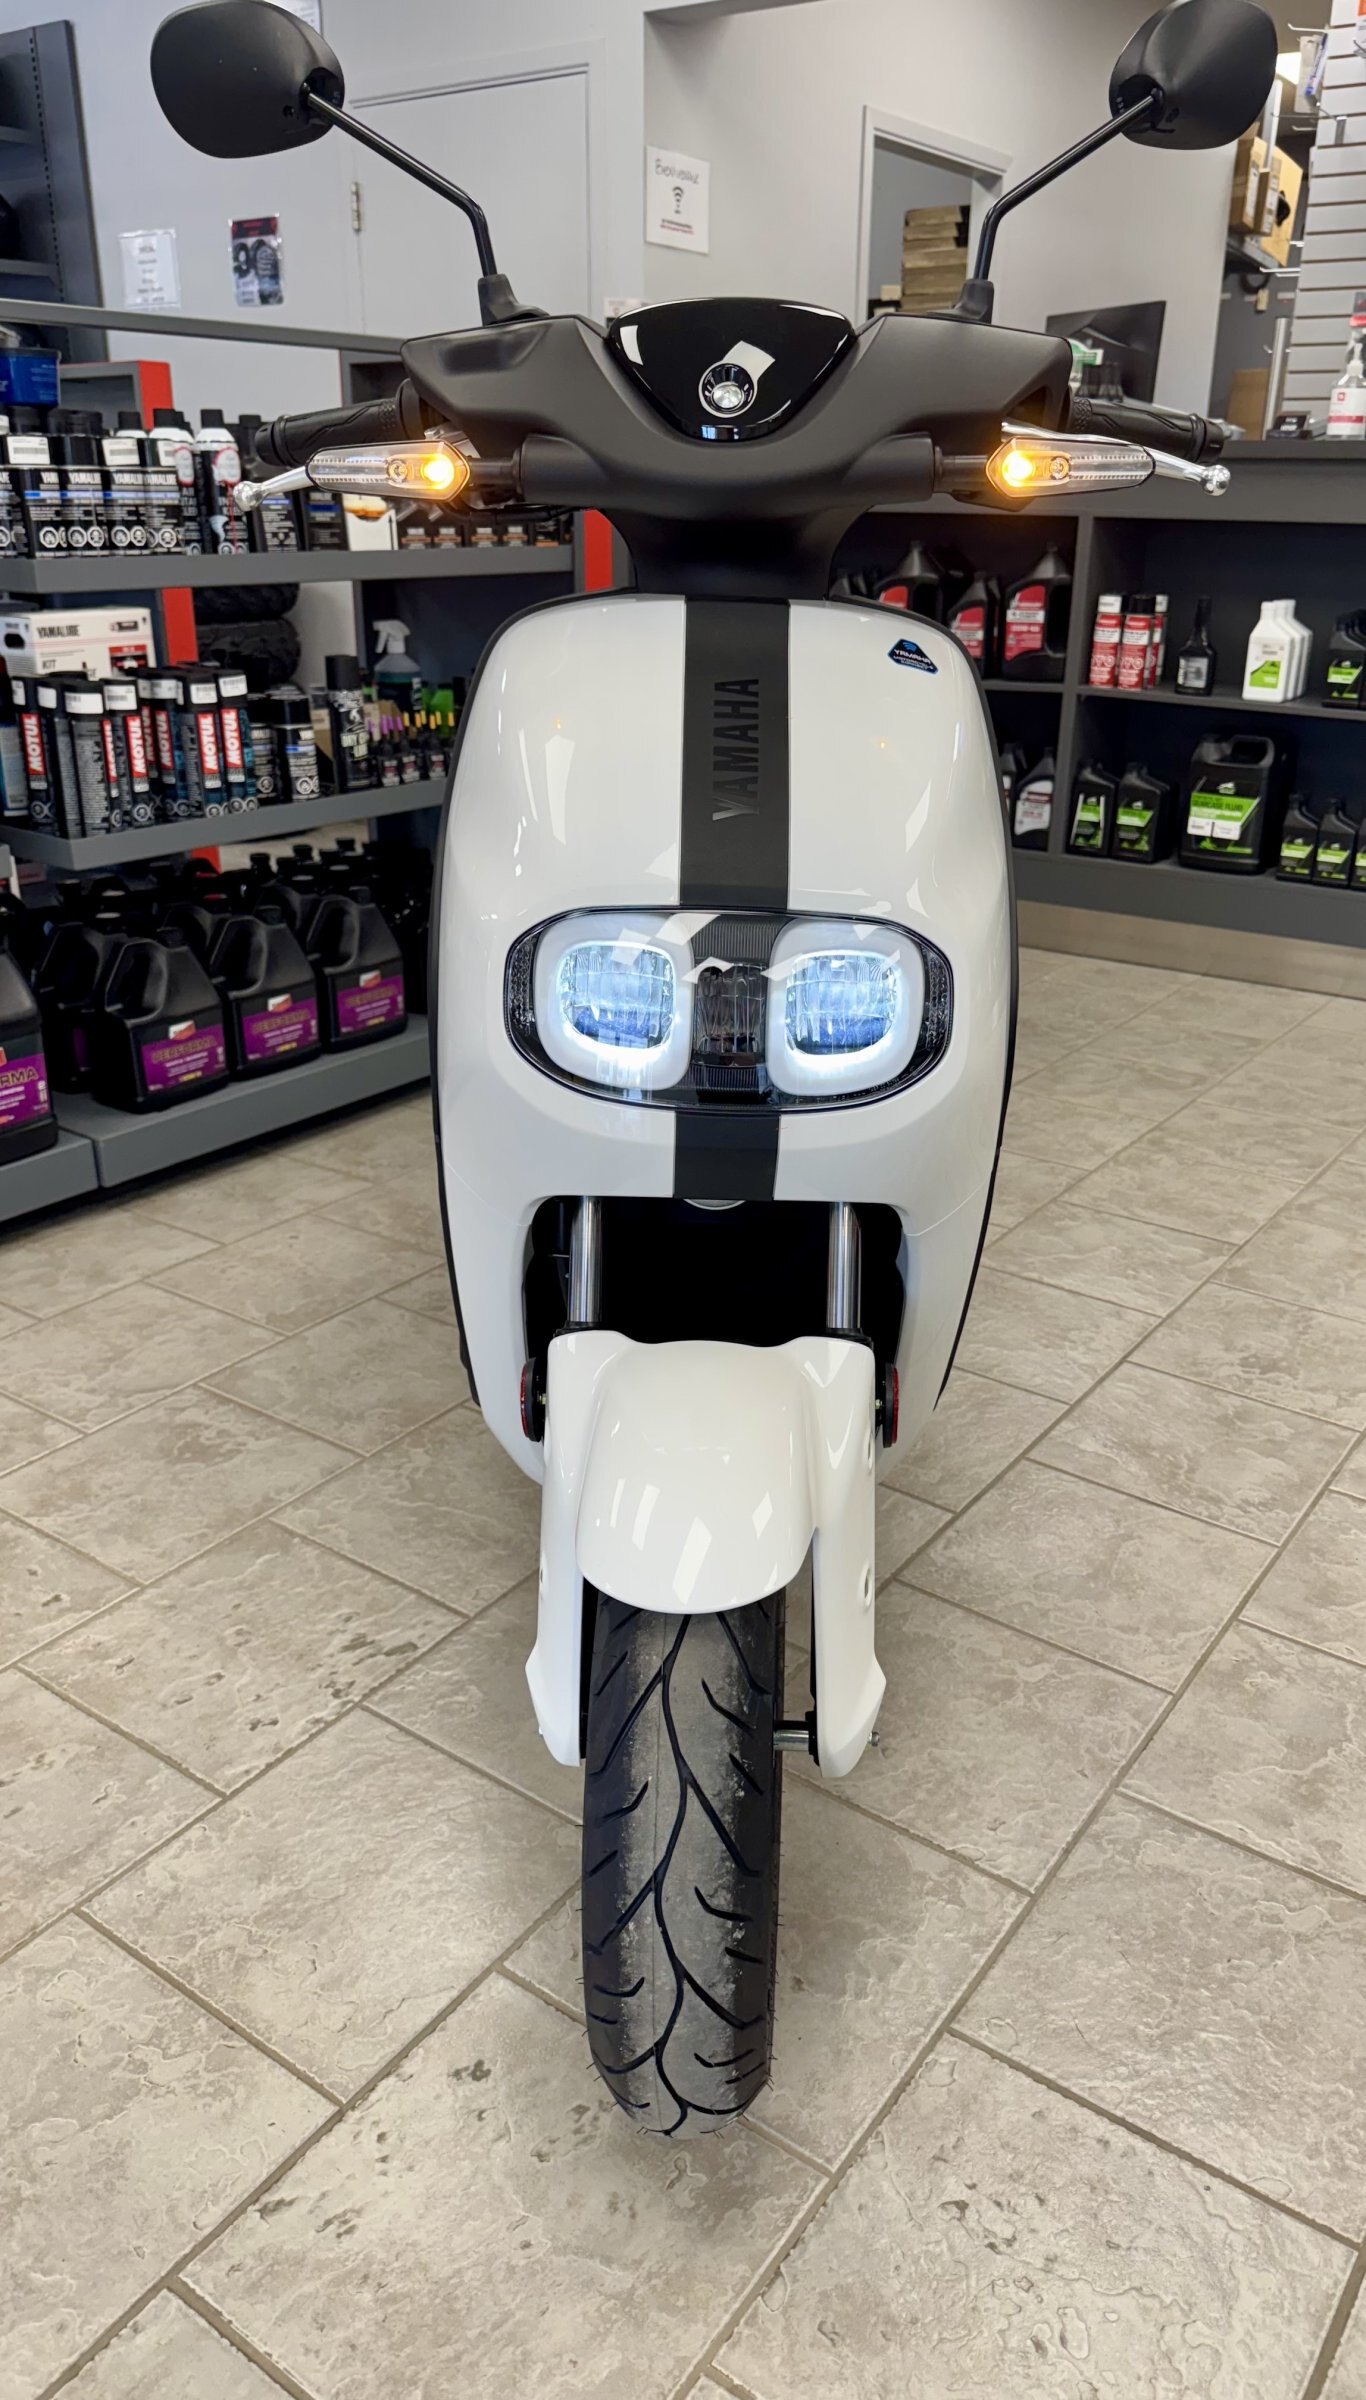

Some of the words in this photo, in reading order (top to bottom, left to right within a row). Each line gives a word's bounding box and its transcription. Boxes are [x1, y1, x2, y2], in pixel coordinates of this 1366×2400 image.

[36, 624, 80, 638] YAMALUBE
[893, 649, 931, 664] YAMAHA
[23, 715, 43, 772] MOTUL
[128, 718, 147, 774] MOTUL
[155, 713, 172, 767] MOTUL
[199, 716, 219, 771] MOTUL
[223, 711, 243, 765] MOTUL
[712, 679, 759, 821] YAMAHA
